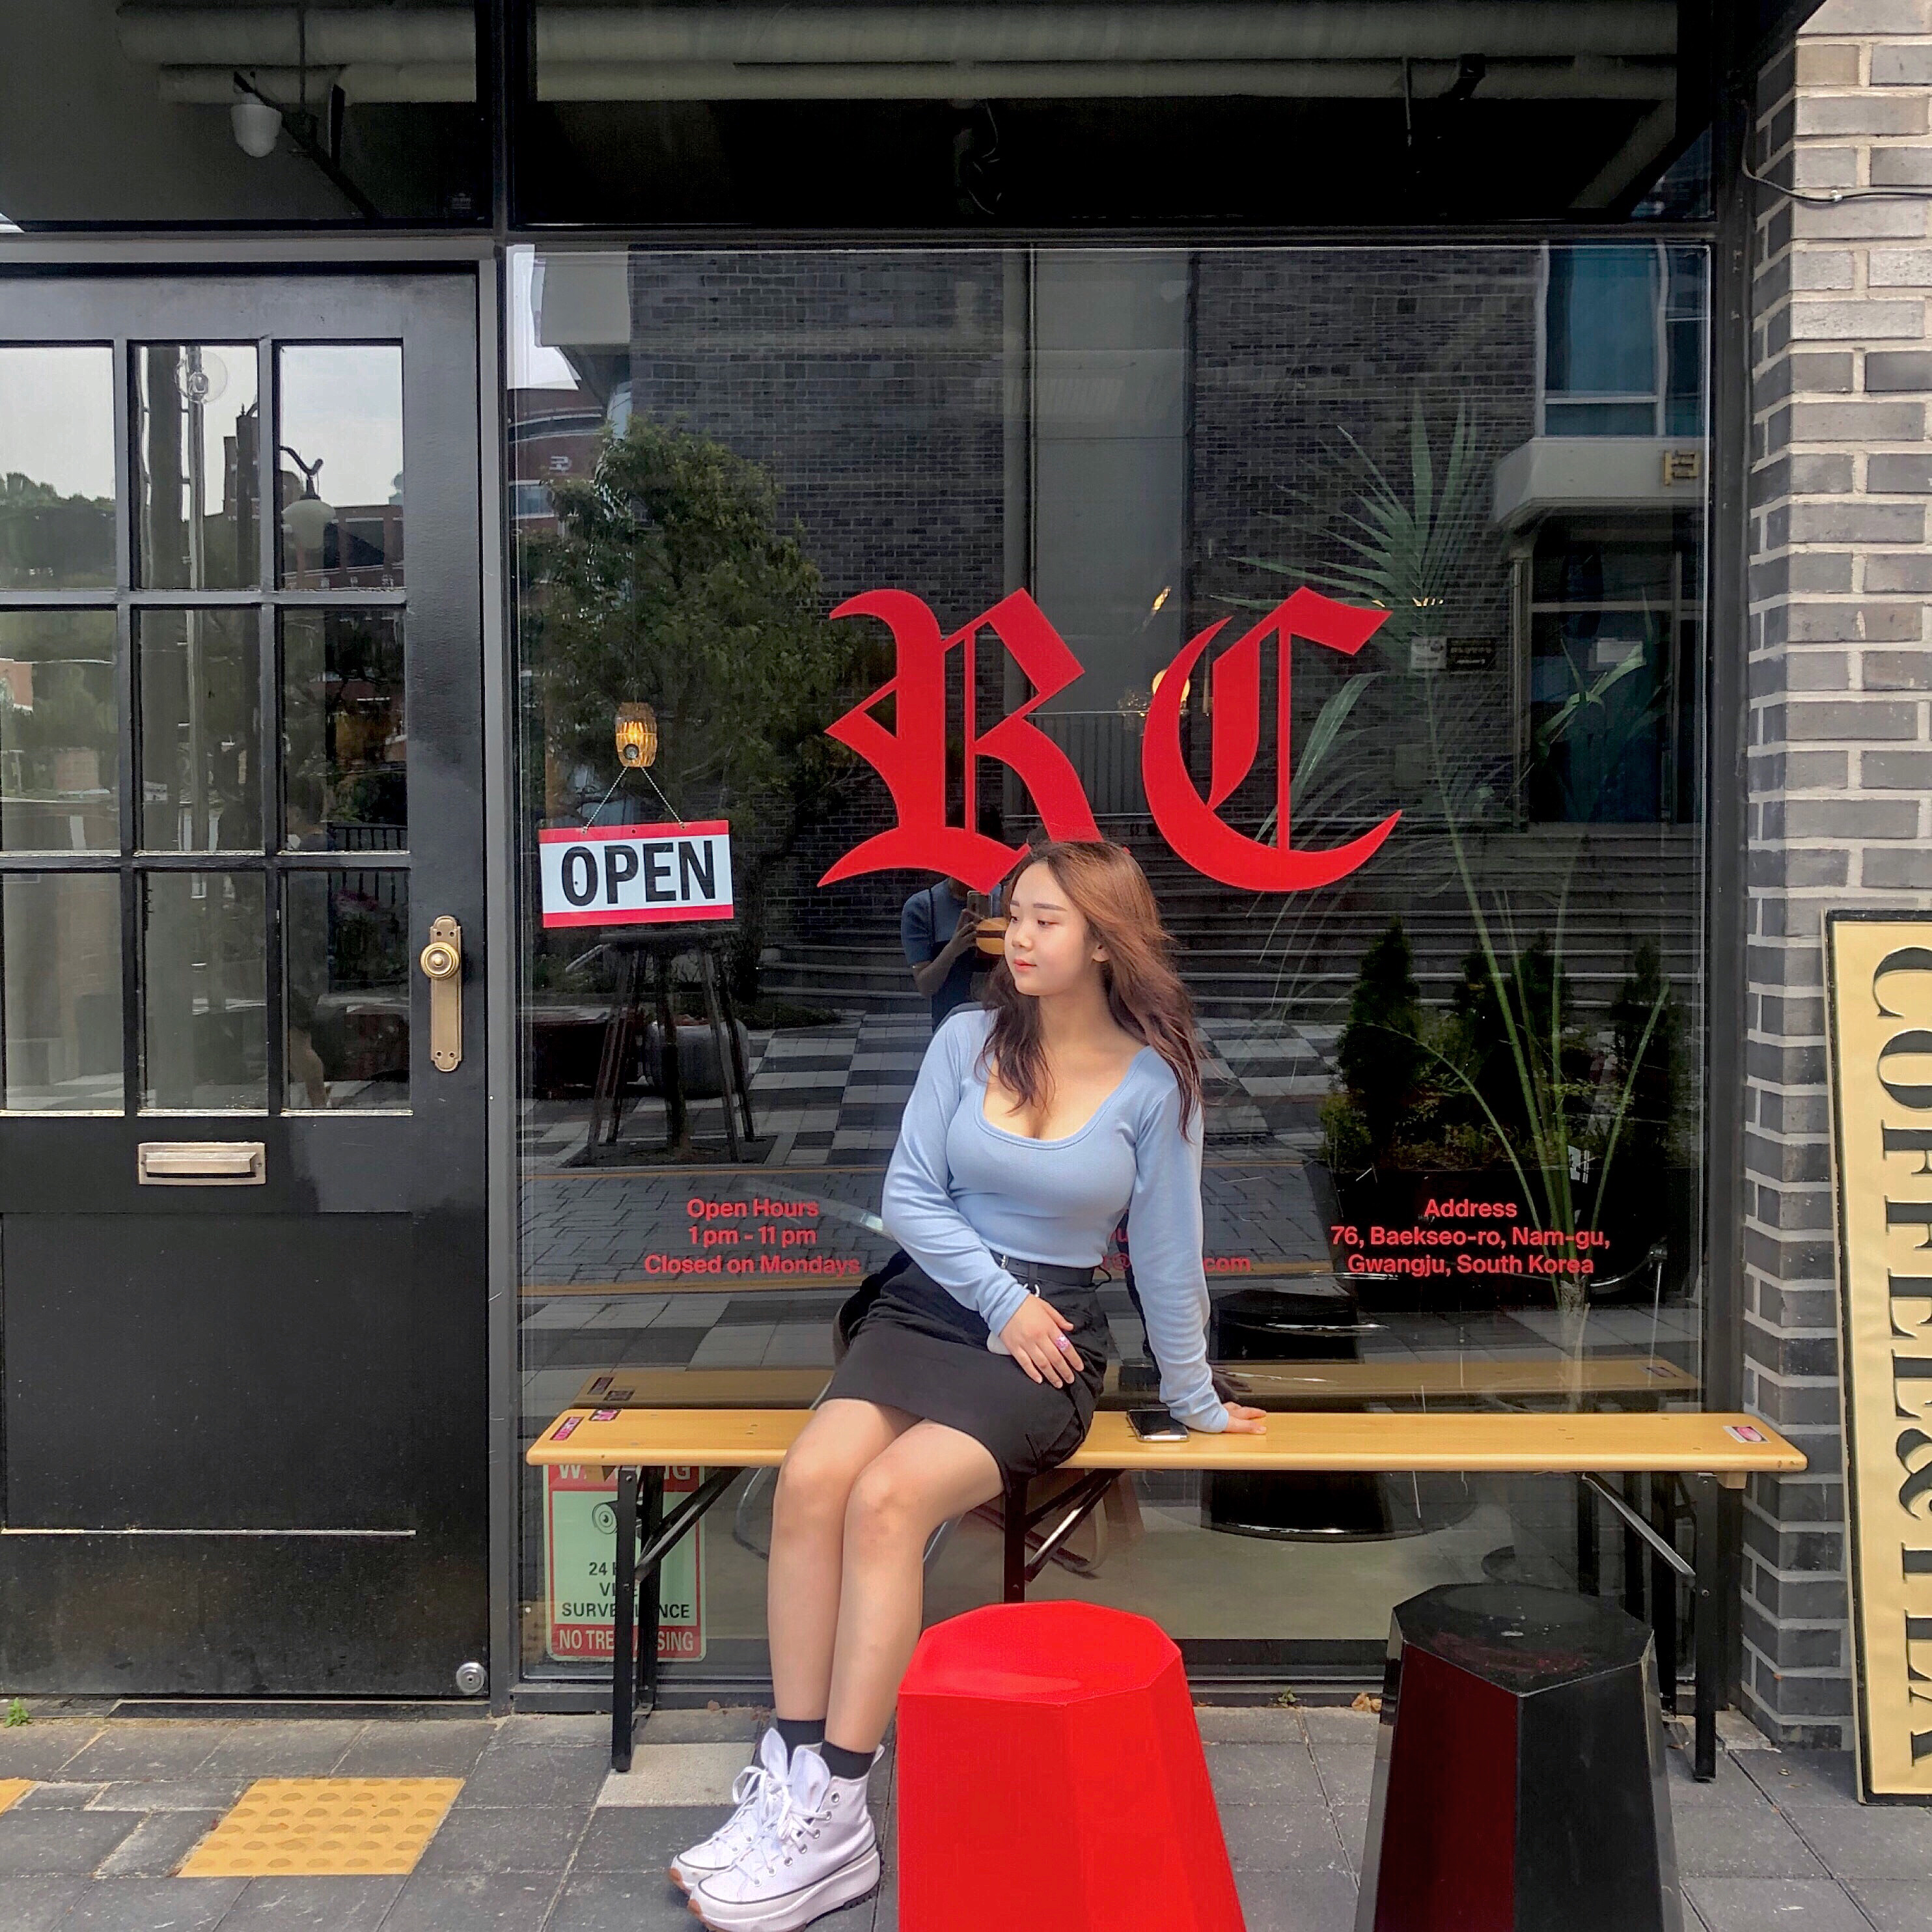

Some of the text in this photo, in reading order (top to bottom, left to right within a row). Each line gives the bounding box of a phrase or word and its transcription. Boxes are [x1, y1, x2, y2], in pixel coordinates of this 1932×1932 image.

[561, 840, 716, 906] OPEN
[687, 1198, 820, 1221] Open Hours
[1423, 1198, 1518, 1218] Address
[689, 1226, 698, 1244] 1
[703, 1228, 739, 1247] pm
[758, 1226, 776, 1244] 11
[781, 1228, 817, 1247] pm
[1331, 1225, 1610, 1250] 76, Baekseo-ro, Nam-gu,
[644, 1254, 861, 1277] Closed on Mondays
[1346, 1254, 1594, 1277] Gwangju, South Korea
[588, 1562, 607, 1576] 24
[562, 1603, 691, 1619] SURVELNCE
[559, 1629, 694, 1651] NO TRESING
